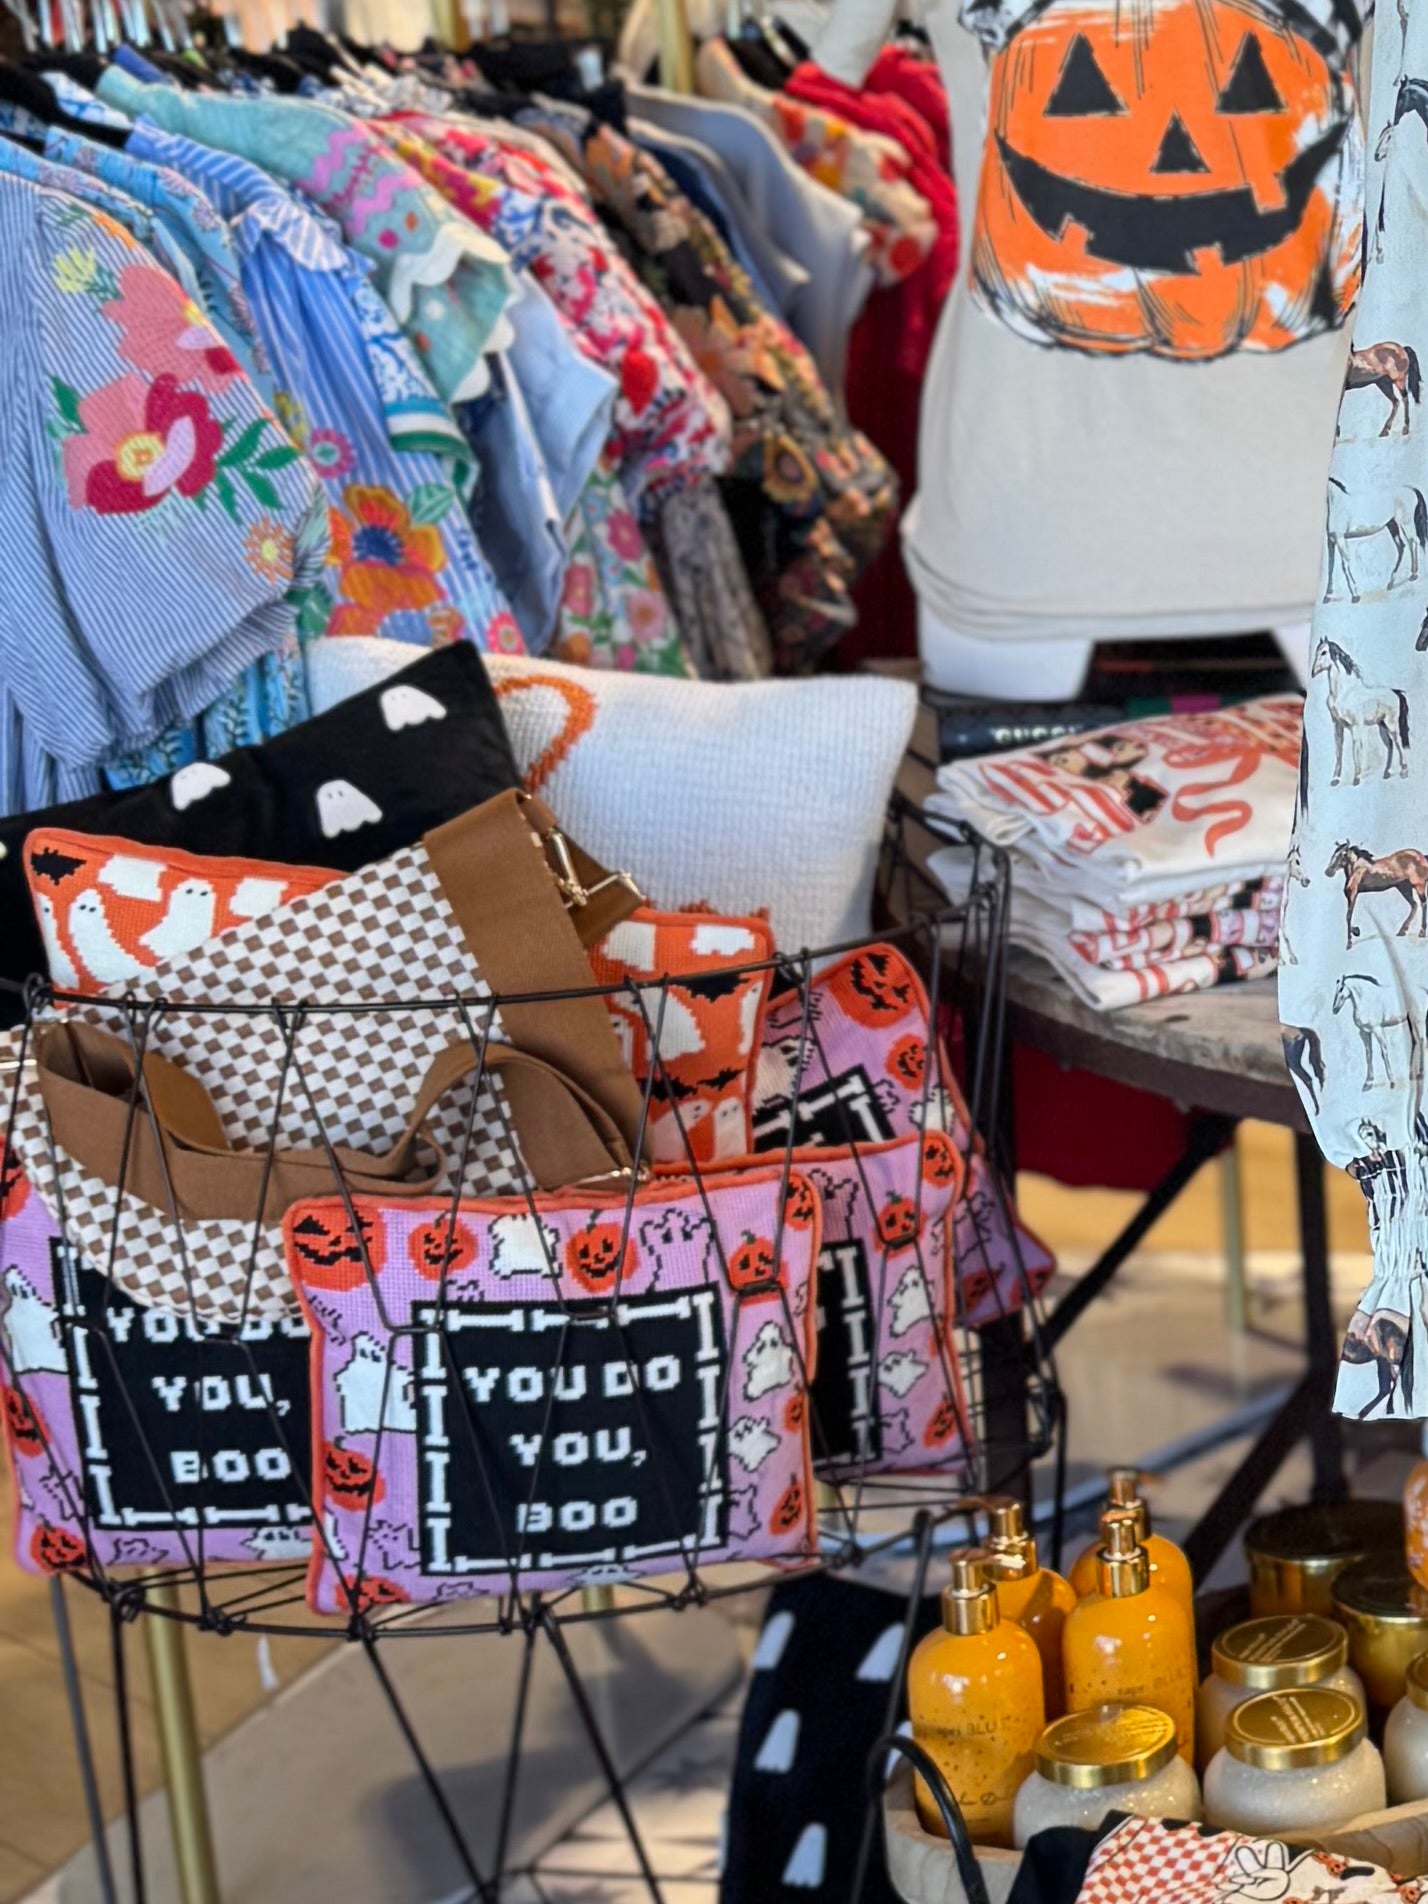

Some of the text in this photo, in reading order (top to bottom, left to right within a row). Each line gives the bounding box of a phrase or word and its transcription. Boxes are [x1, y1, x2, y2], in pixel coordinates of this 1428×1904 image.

[106, 1306, 221, 1343] YOU
[151, 1373, 291, 1416] YOU,
[463, 1354, 681, 1403] YOU DO
[170, 1447, 292, 1484] BOO
[509, 1426, 648, 1467] YOU,
[516, 1496, 638, 1533] BOO
